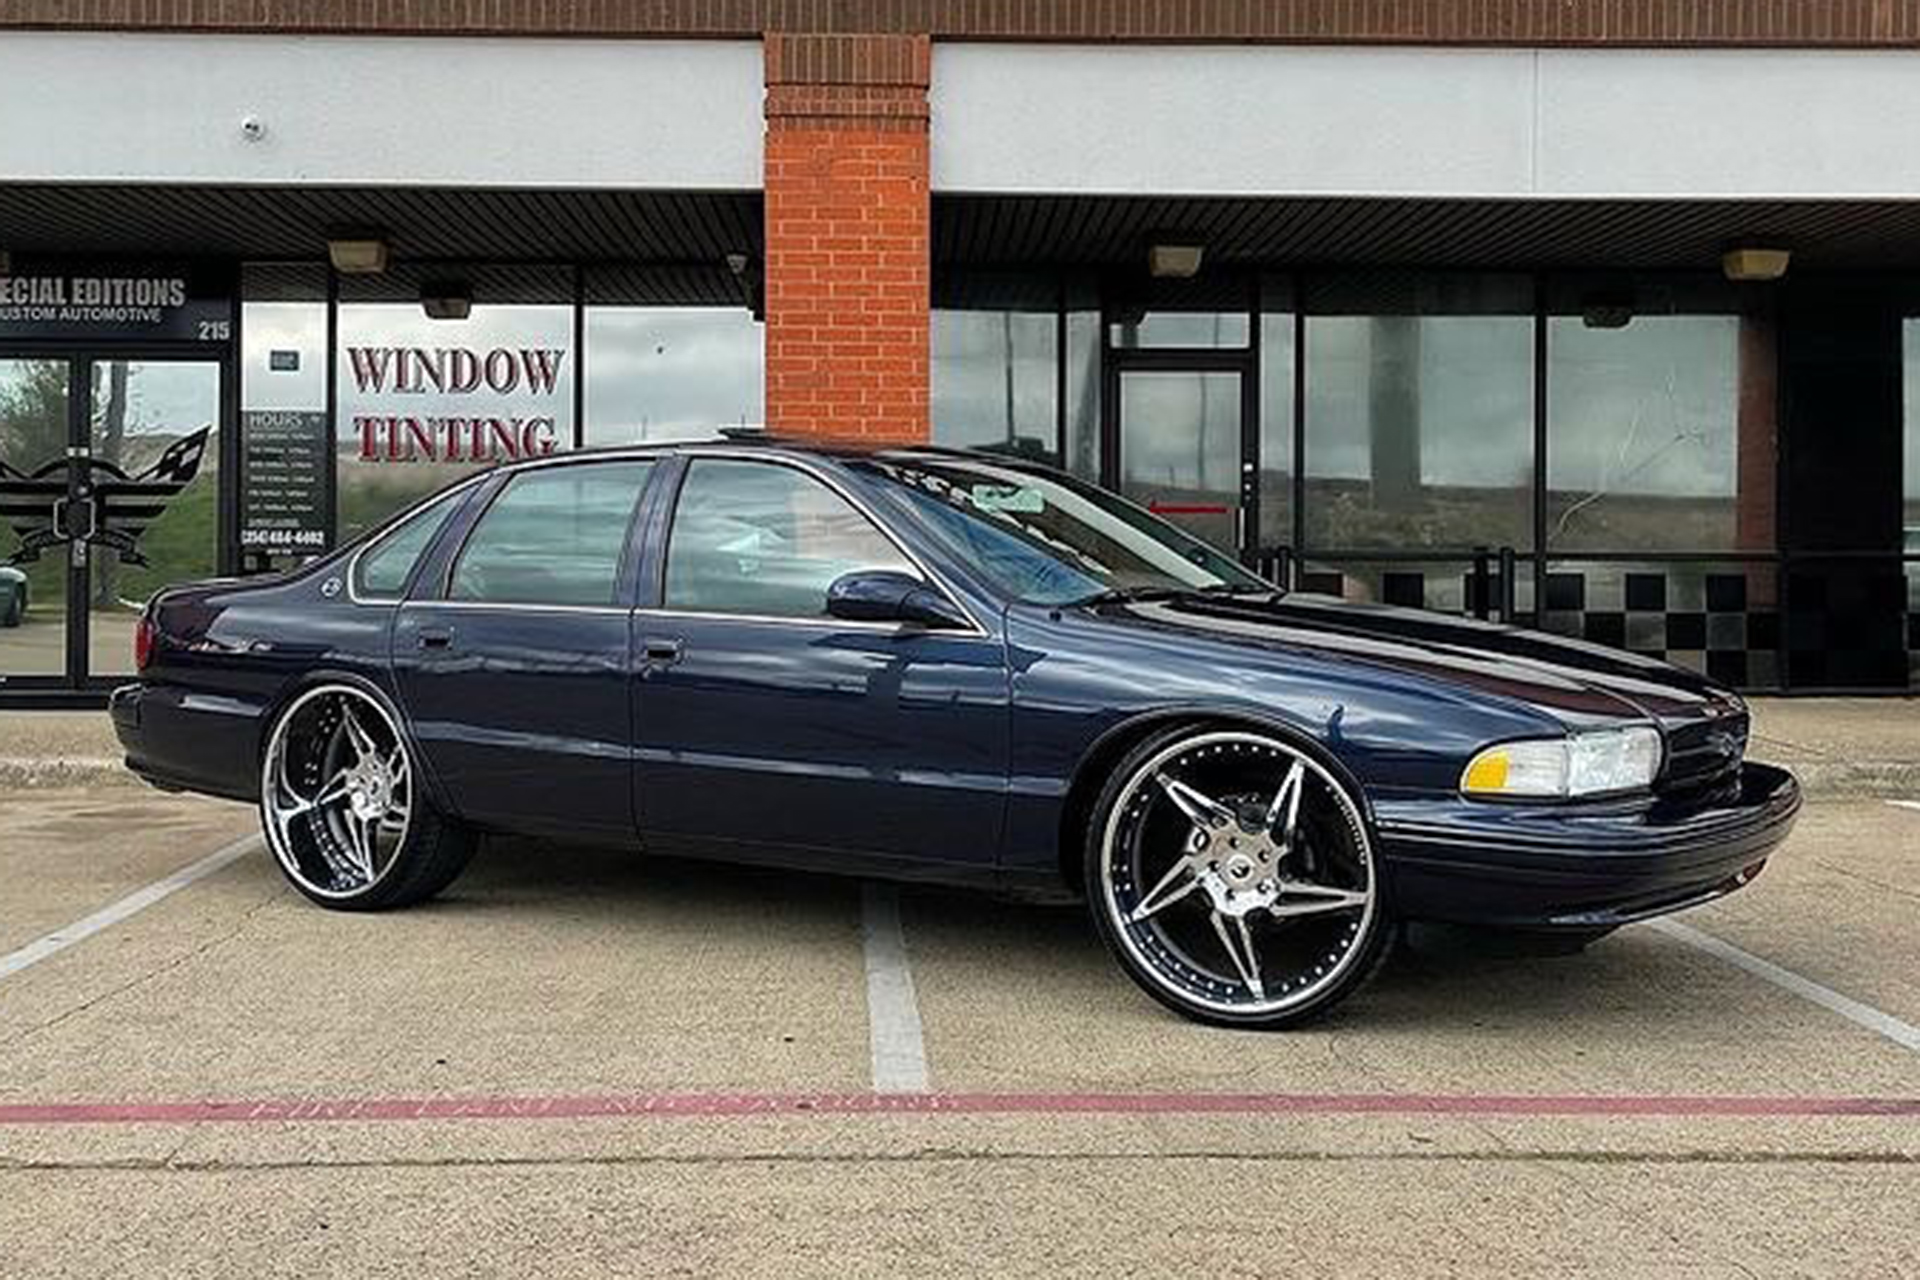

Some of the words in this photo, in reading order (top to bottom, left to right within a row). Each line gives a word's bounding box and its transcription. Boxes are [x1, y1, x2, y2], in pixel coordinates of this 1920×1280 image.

[72, 277, 185, 307] EDITIONS
[59, 306, 162, 323] AUTOMOTIVE
[198, 321, 230, 341] 215
[347, 347, 566, 394] WINDOW
[353, 415, 559, 463] TINTING
